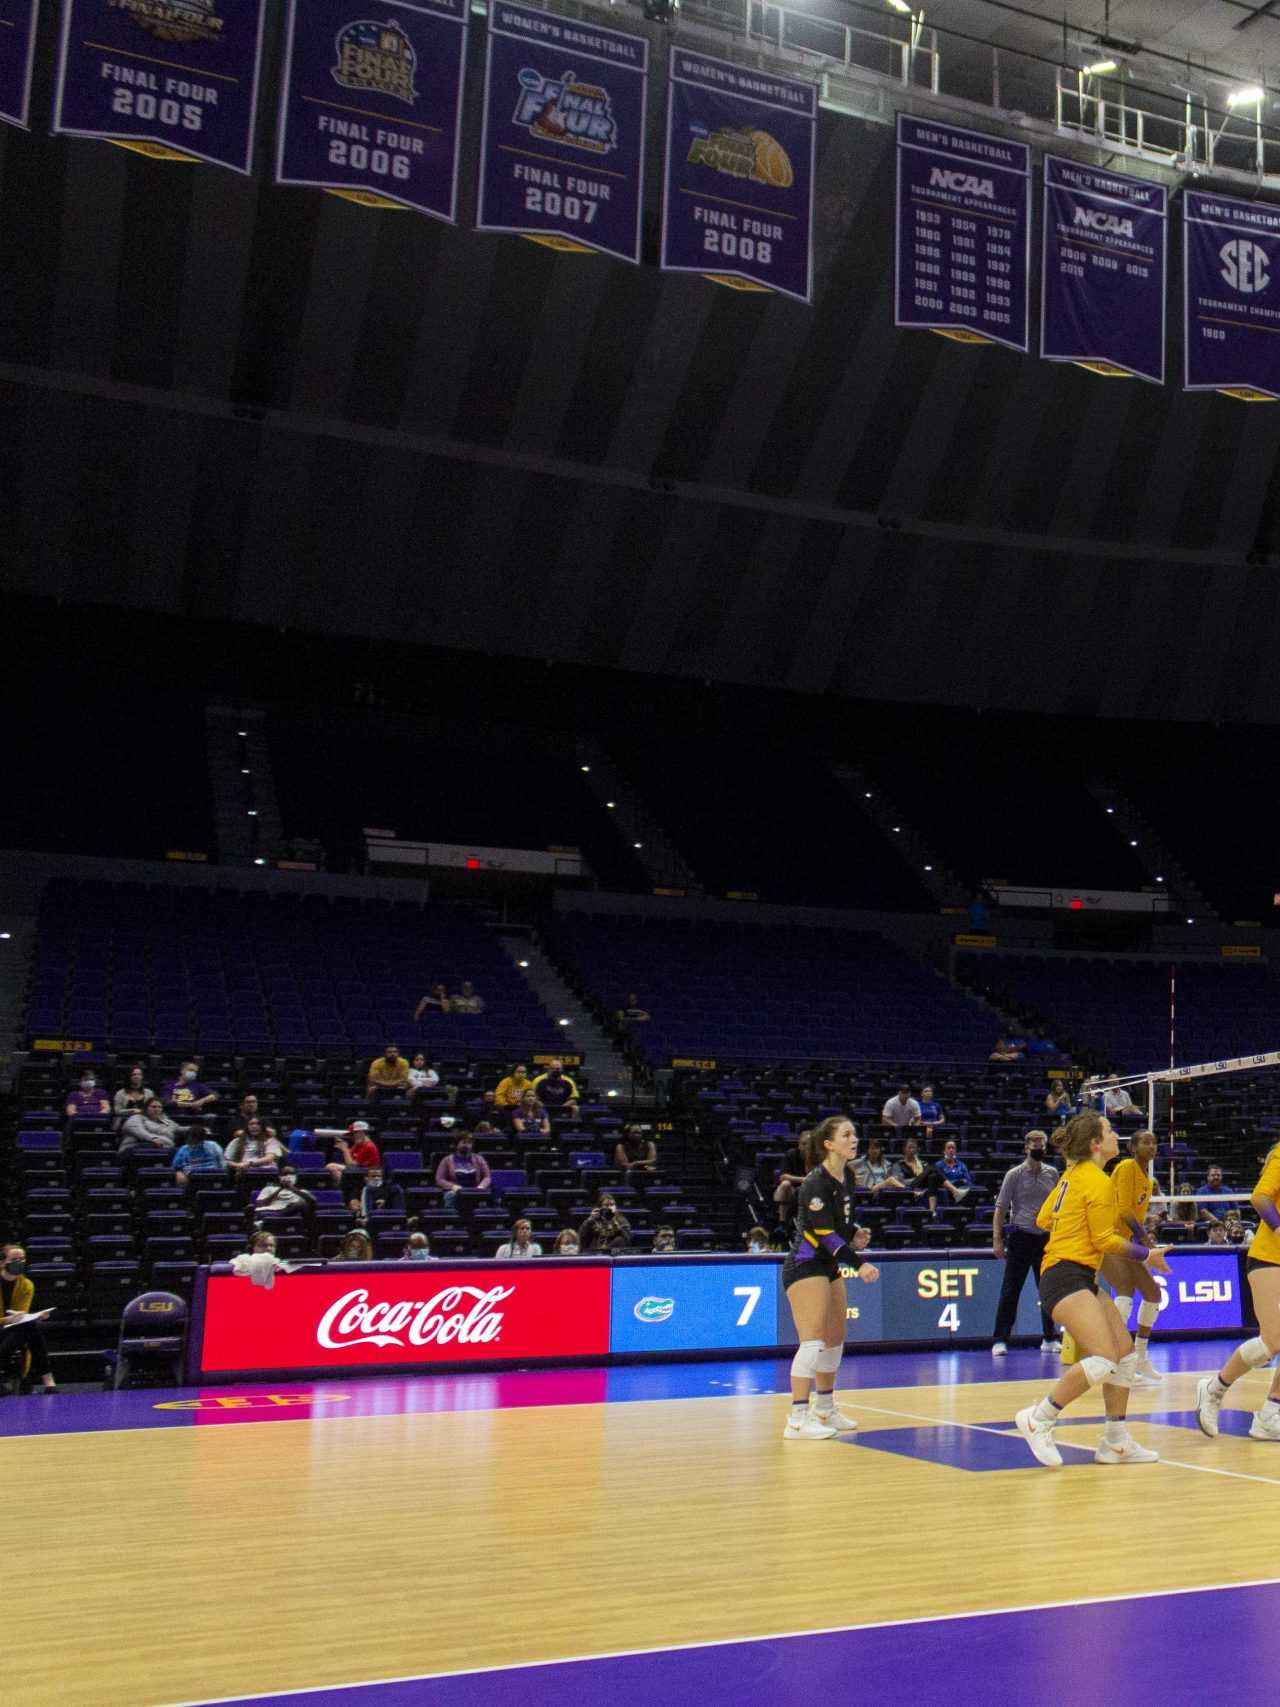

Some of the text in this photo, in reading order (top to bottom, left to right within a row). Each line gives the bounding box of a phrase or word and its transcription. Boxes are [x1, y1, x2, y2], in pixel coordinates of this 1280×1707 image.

[502, 13, 637, 58] WOMEN'S BASKETBALL
[101, 62, 218, 104] FINAL FOUR
[682, 60, 805, 104] WOMEN'S BASKETBALL
[111, 87, 203, 131] 2005
[318, 115, 424, 155] FINAL FOUR
[916, 128, 1012, 162] MEN'S BASKETBALL
[328, 140, 411, 180] 2006
[513, 164, 610, 201] FINAL FOUR
[929, 168, 994, 199] NCAA
[1094, 177, 1150, 201] BASKETBALL
[525, 188, 598, 224] 2007
[1073, 207, 1134, 238] NCAA
[1201, 203, 1229, 218] MEN'S
[694, 207, 783, 240] FINAL FOUR
[703, 229, 772, 264] 2008
[1219, 239, 1270, 293] SEC
[915, 278, 938, 292] 1991
[914, 295, 943, 310] 2000
[949, 302, 977, 317] 2003
[1198, 297, 1247, 313] TOURNAMENT
[1252, 1055, 1265, 1064] LSU
[917, 1268, 978, 1298] SET
[1179, 1280, 1232, 1302] LSU
[139, 1302, 173, 1313] LSU
[317, 1285, 516, 1349] Coca-Cola
[733, 1287, 761, 1326] 7
[938, 1303, 960, 1332] 4
